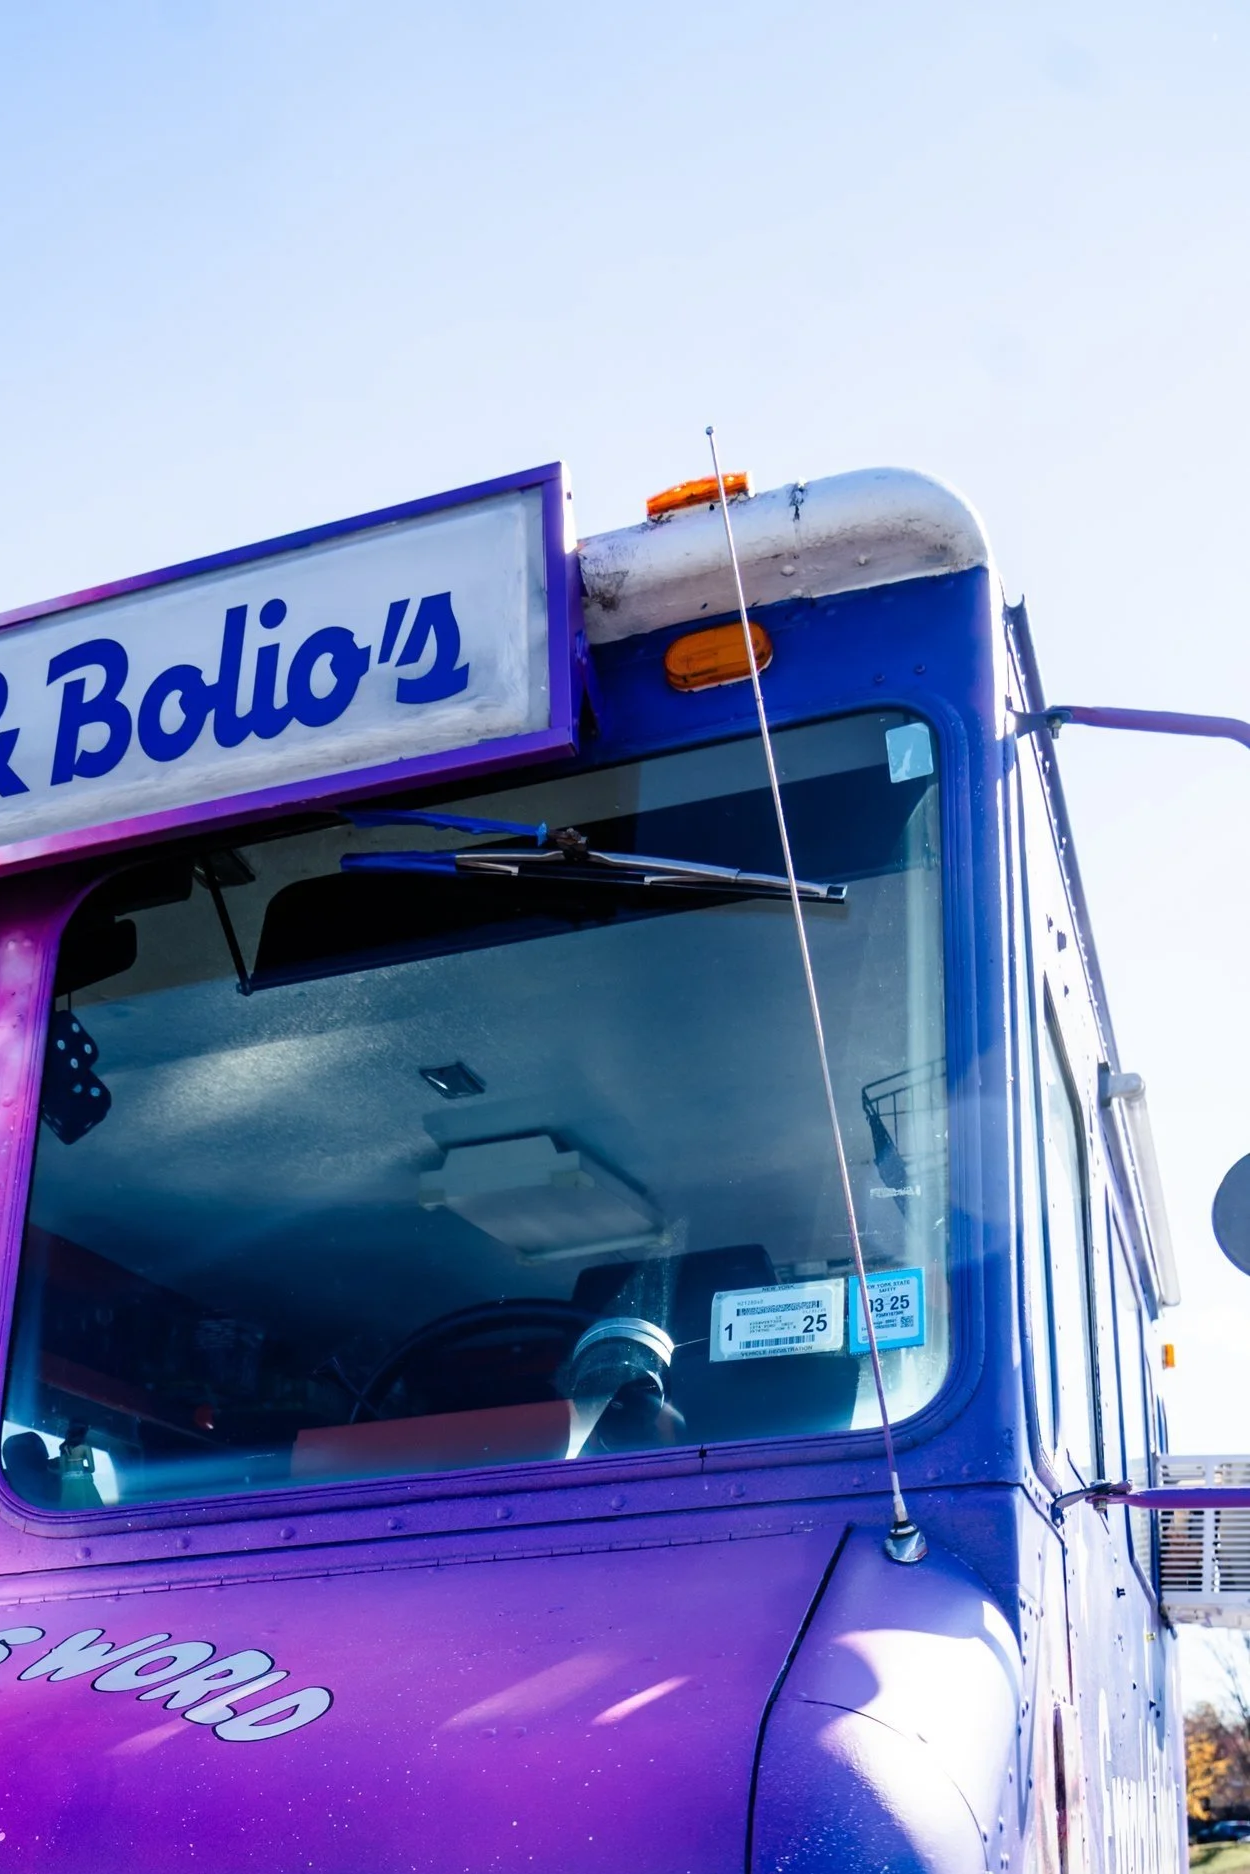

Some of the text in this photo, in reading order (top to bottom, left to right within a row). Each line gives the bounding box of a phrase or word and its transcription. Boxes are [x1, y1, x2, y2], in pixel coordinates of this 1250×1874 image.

[47, 591, 469, 785] Bolio's
[724, 1323, 733, 1341] 1
[802, 1314, 827, 1333] 25
[19, 1627, 334, 1743] WORLD
